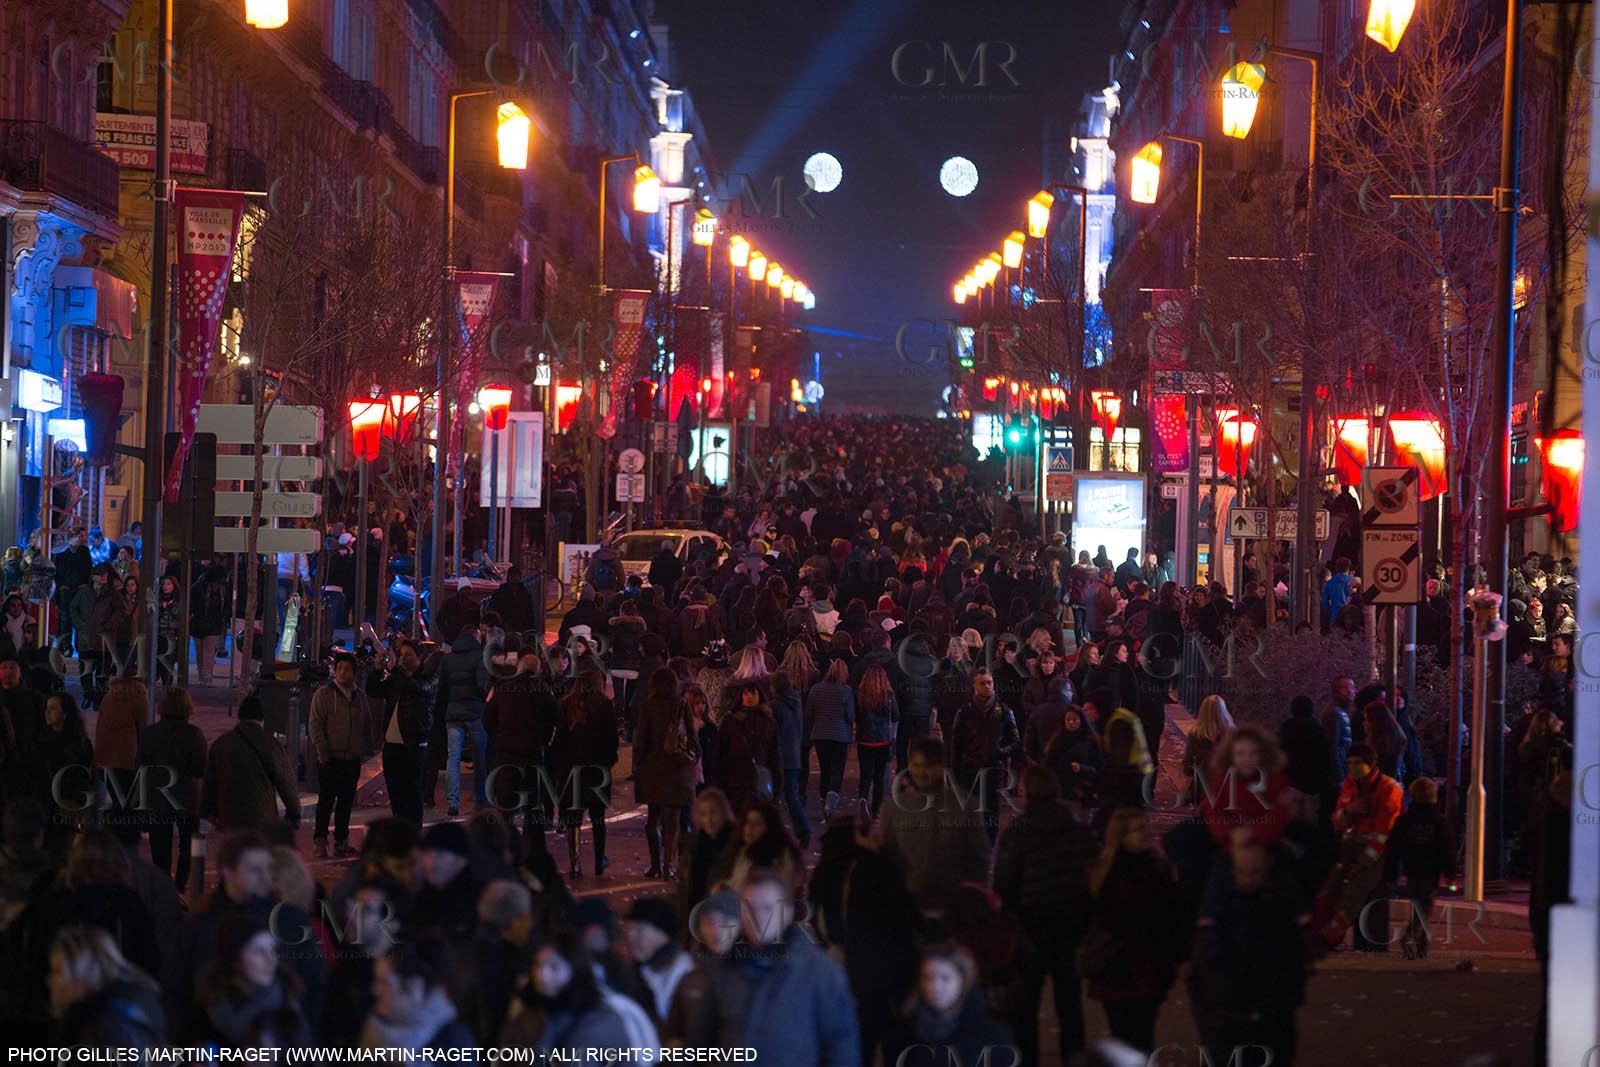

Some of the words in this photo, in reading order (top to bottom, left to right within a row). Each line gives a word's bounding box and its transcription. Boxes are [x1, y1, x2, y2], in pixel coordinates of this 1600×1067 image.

[113, 133, 143, 144] FRAIS
[122, 152, 149, 165] 500
[189, 217, 227, 225] MARSEILLE
[1366, 533, 1381, 542] FIN
[1390, 533, 1415, 542] ZONE
[1380, 567, 1401, 583] 30
